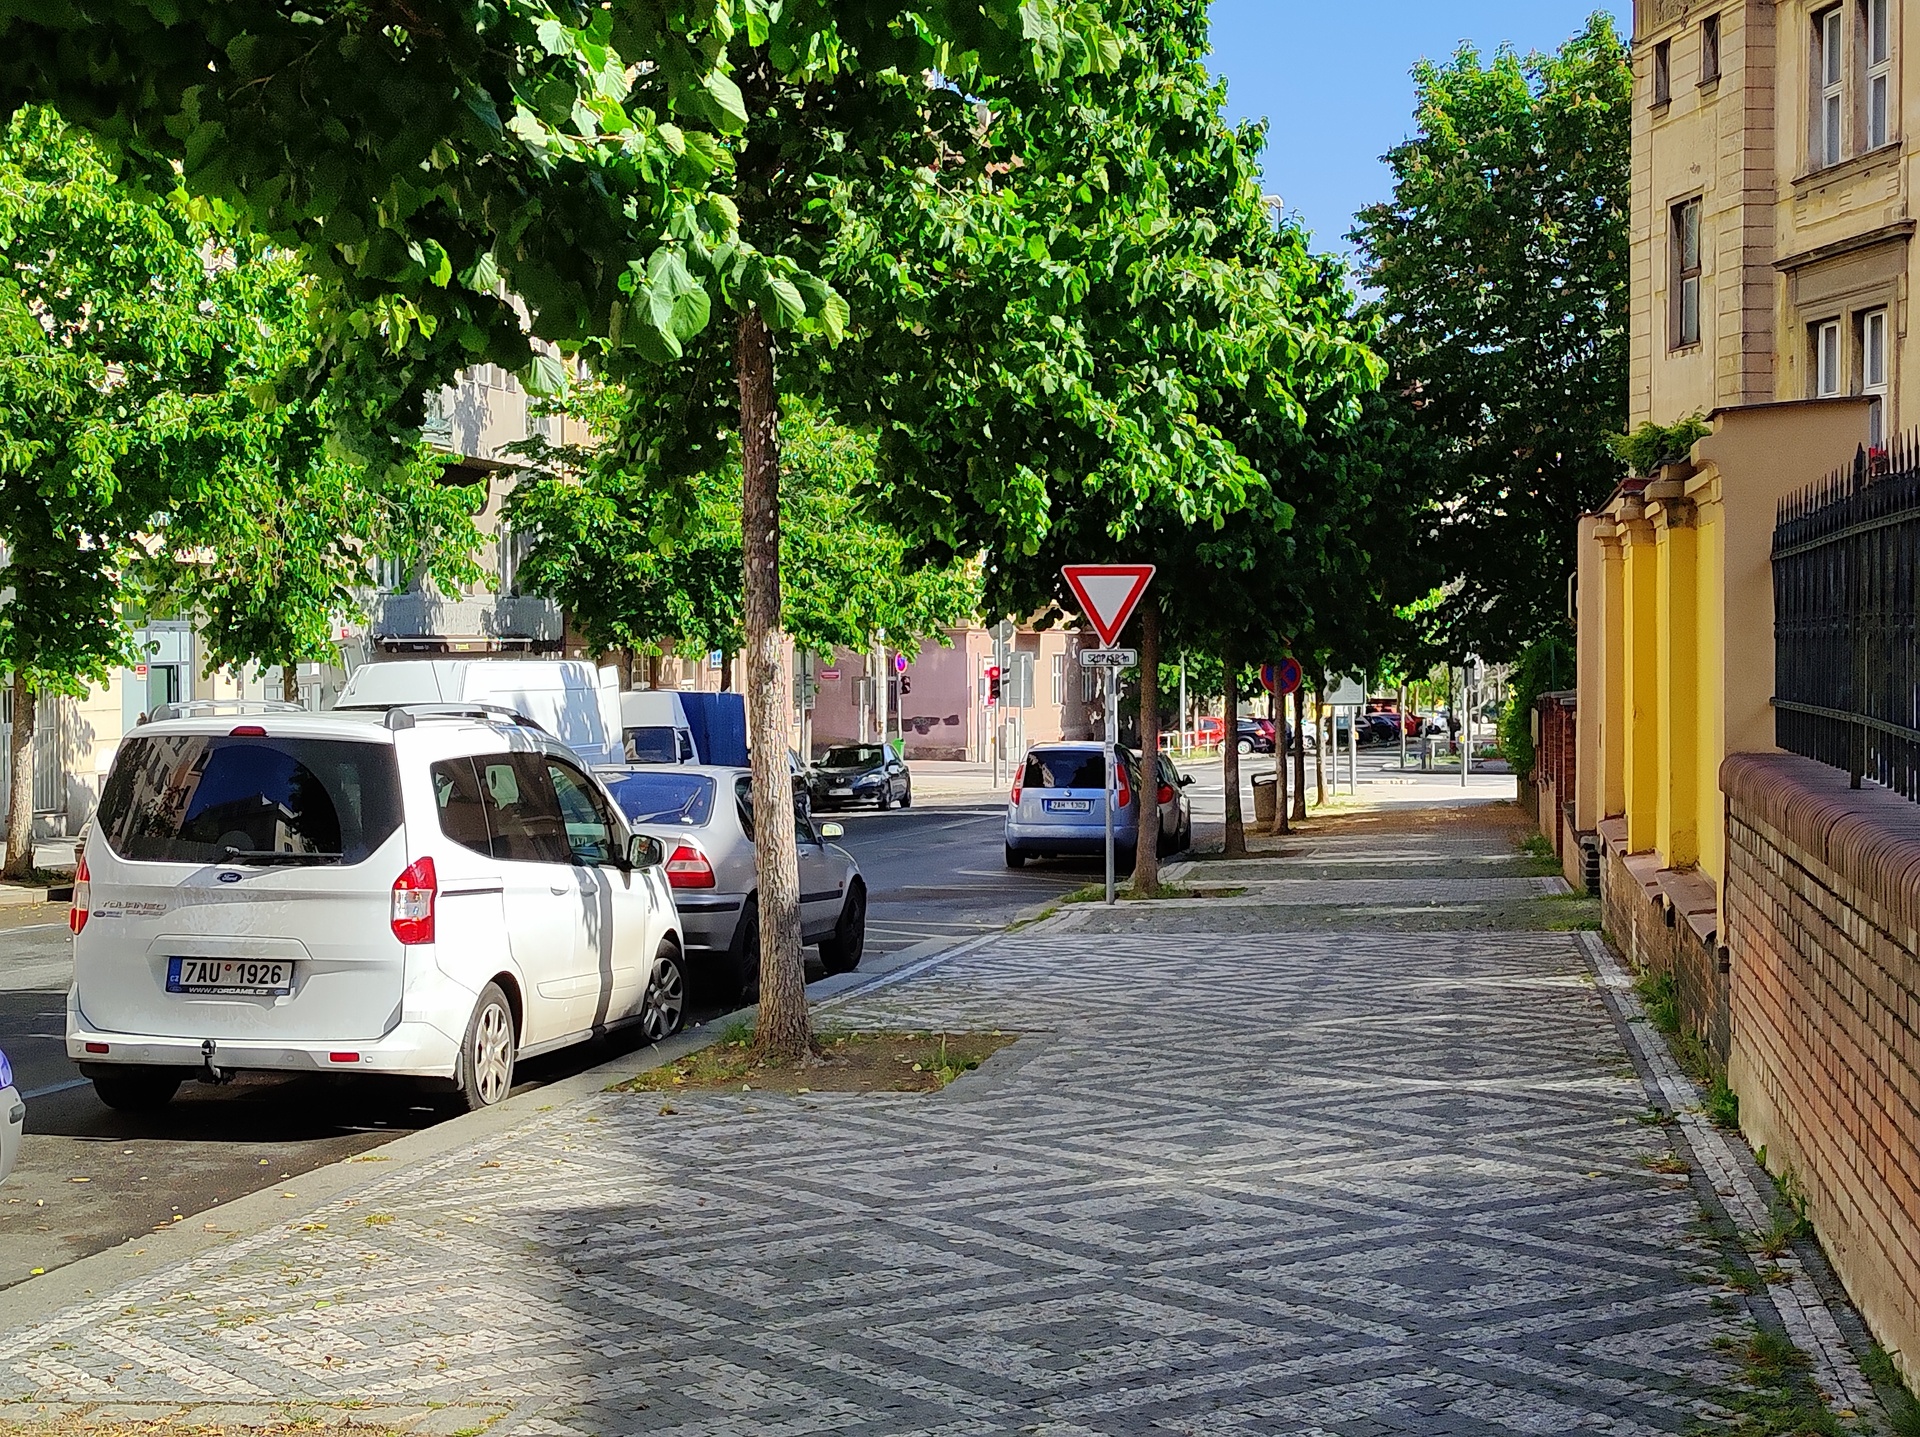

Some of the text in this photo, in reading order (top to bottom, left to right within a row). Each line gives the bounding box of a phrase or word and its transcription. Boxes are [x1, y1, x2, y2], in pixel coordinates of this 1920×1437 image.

[170, 975, 179, 983] CZ
[184, 962, 283, 985] 7AU 1926
